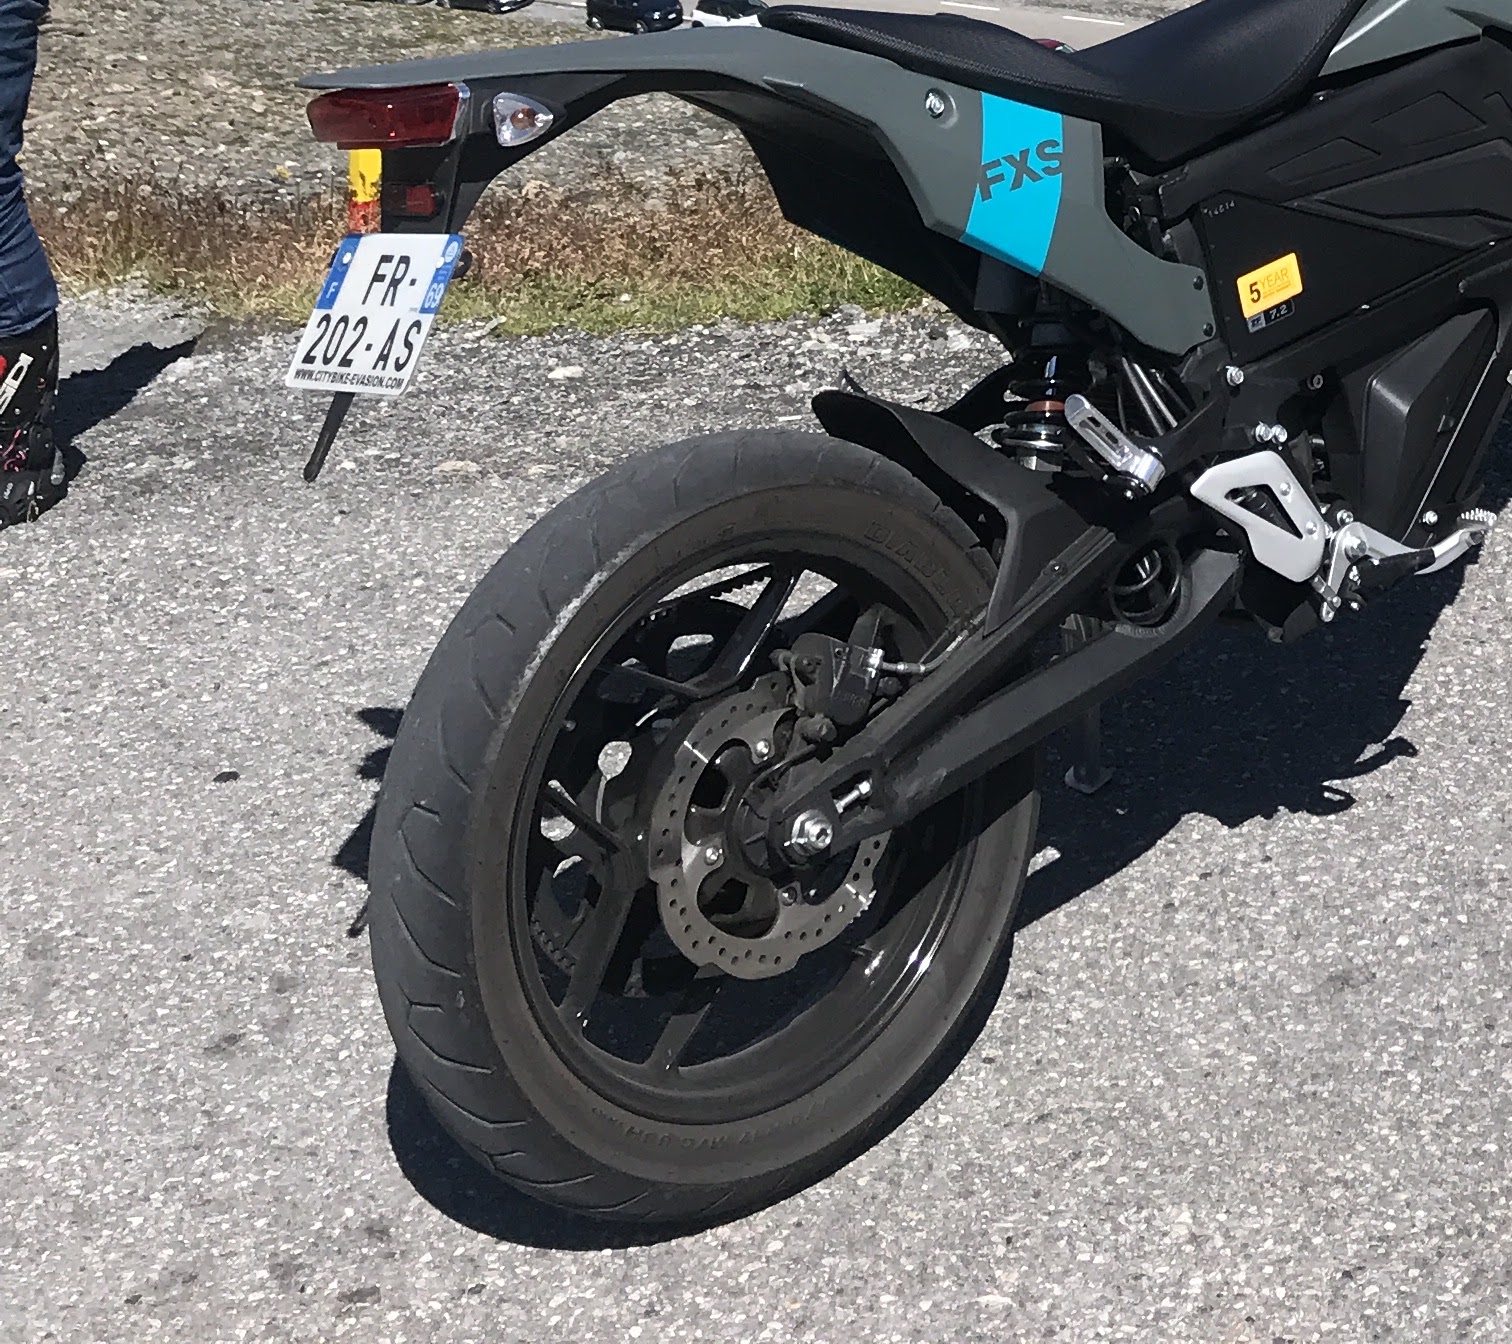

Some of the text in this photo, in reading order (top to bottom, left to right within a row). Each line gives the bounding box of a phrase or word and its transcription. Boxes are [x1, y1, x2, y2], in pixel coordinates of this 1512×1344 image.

[977, 139, 1064, 203] FXS
[326, 281, 339, 299] F
[424, 282, 445, 309] 69
[1249, 281, 1262, 304] 5
[1259, 267, 1290, 289] YEAR
[1269, 304, 1288, 320] 7.2
[301, 313, 422, 373] 202-AS
[294, 368, 405, 390] WWW.CITYBIKE-EVASION.COM
